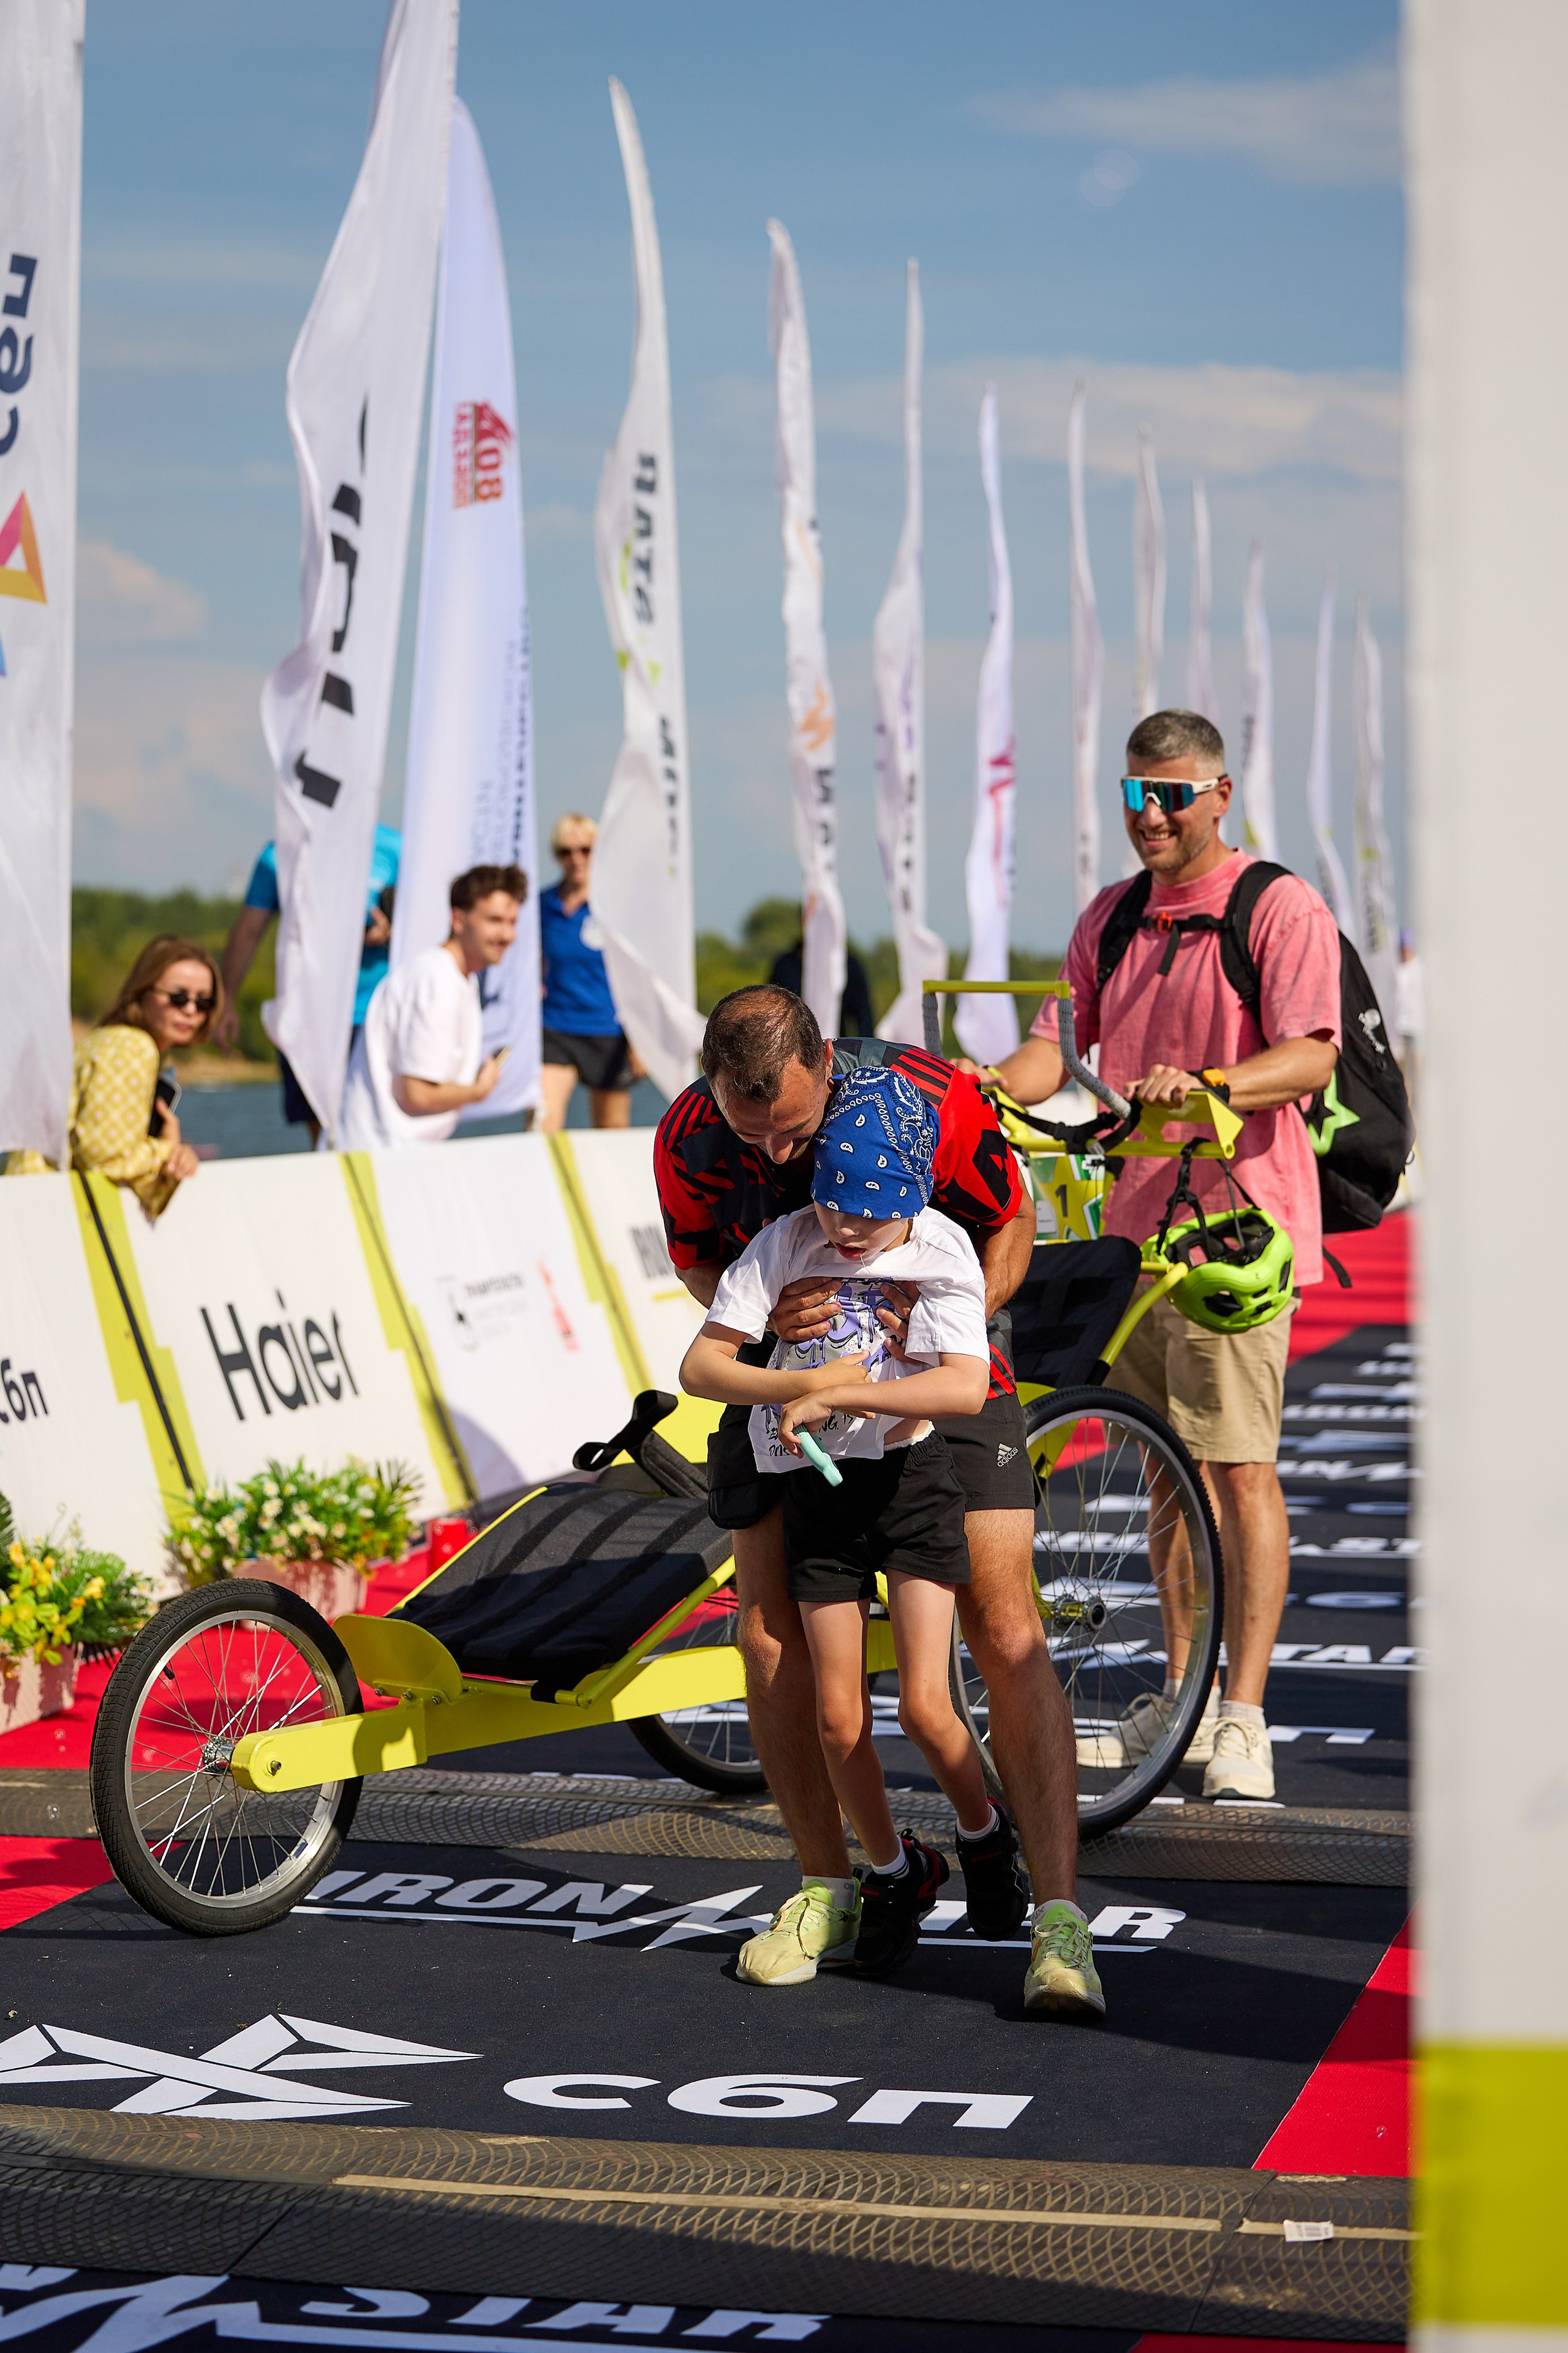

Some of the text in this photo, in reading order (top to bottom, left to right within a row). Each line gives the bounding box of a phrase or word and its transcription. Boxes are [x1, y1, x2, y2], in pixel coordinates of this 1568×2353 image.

[1055, 1184, 1068, 1218] 1
[200, 1287, 360, 1422] Haier
[0, 1359, 48, 1422] бп
[997, 1447, 1018, 1467] adidas
[304, 1870, 654, 1914] IRON
[503, 2074, 1035, 2129] сбп
